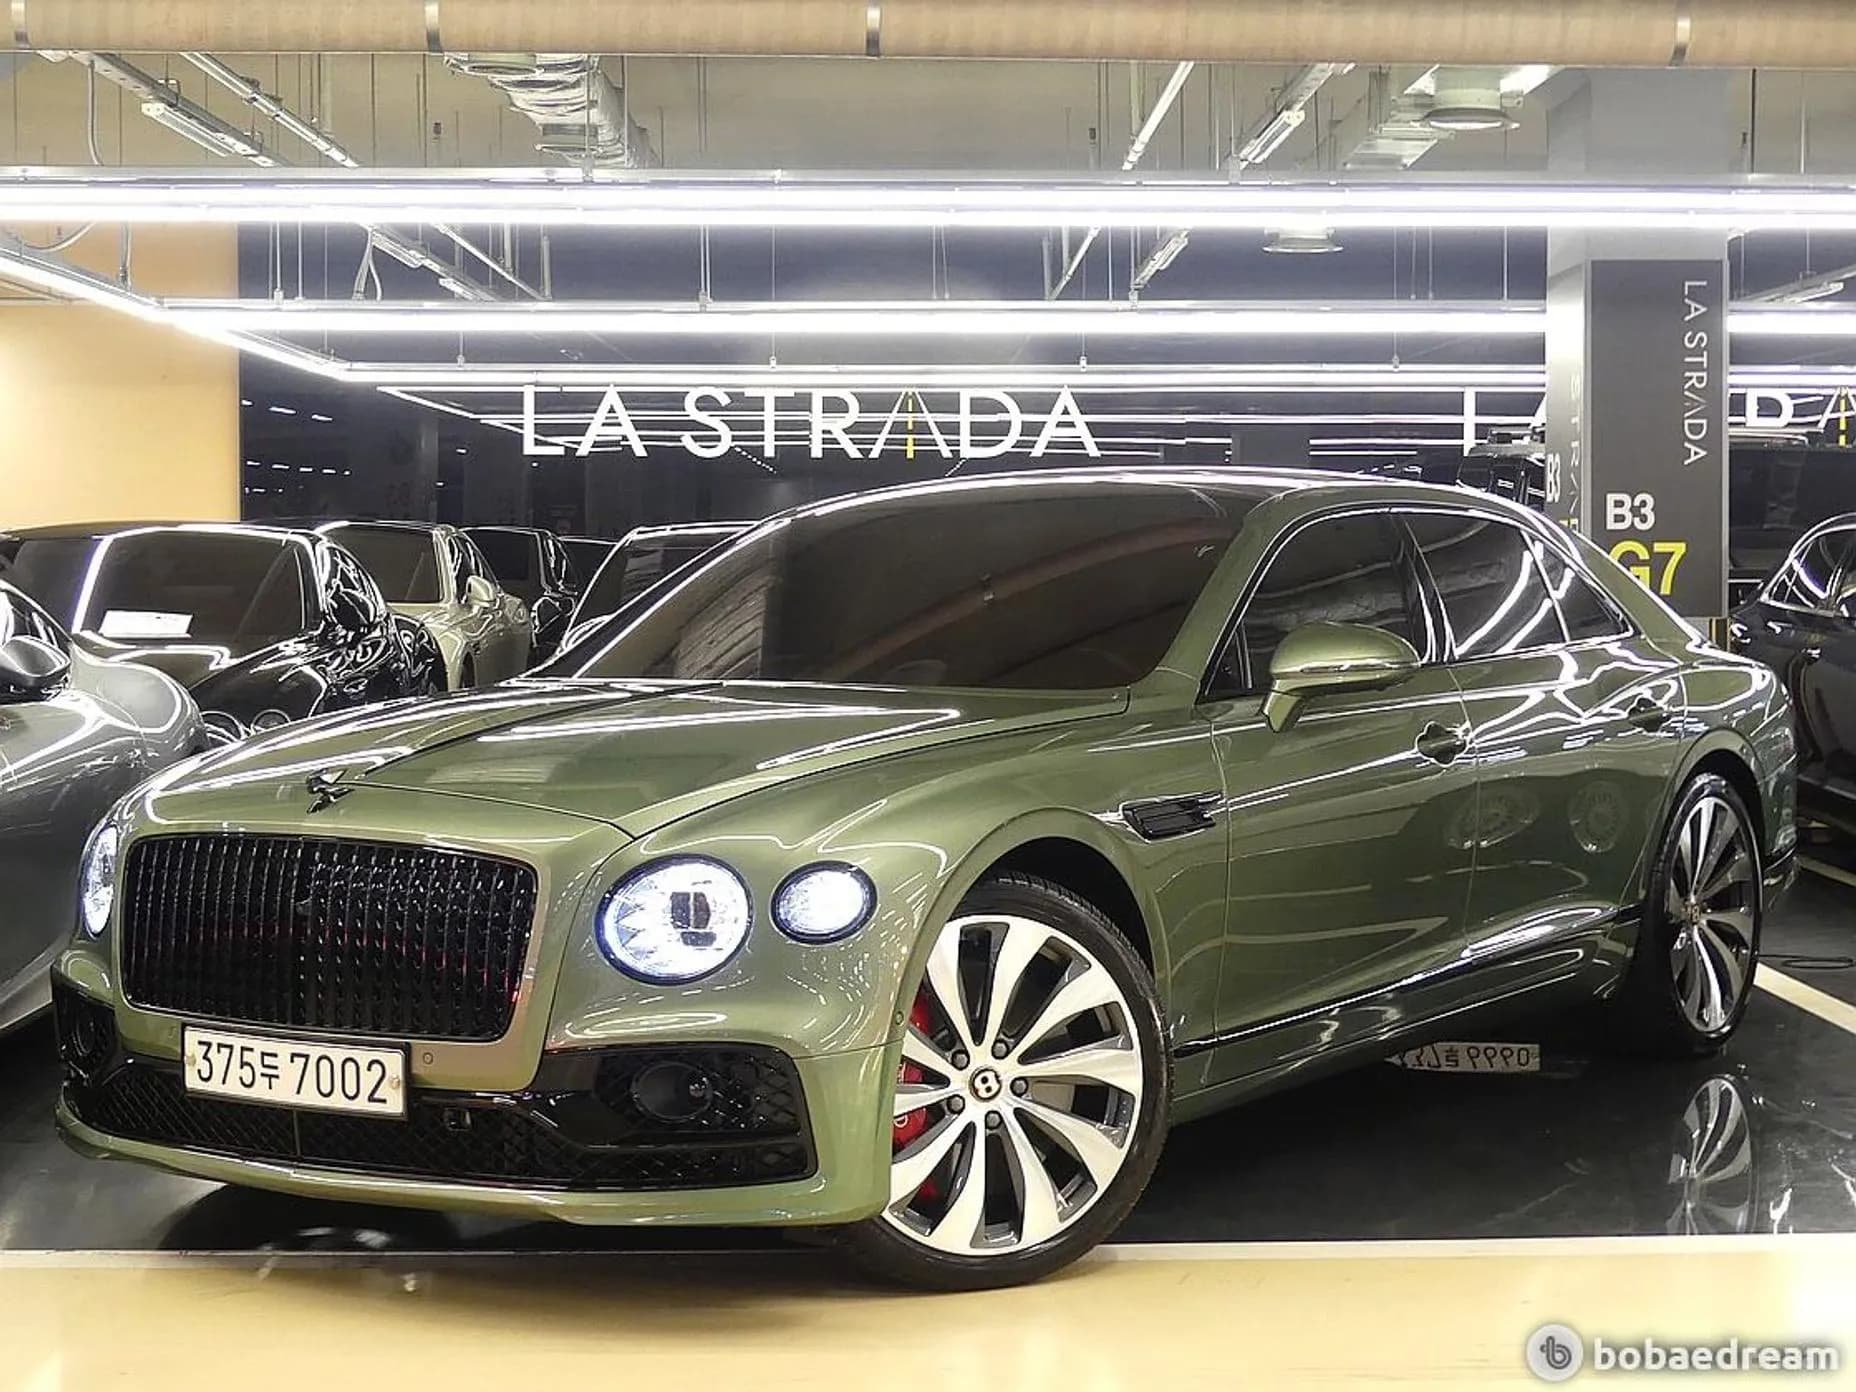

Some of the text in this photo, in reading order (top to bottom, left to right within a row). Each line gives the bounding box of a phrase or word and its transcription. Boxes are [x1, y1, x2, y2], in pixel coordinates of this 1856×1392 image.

[1683, 280, 1708, 466] LA STRADA
[522, 383, 1101, 459] LA STRADA
[1605, 493, 1656, 531] B3
[1608, 540, 1687, 596] G7
[197, 1039, 388, 1104] 375두 7002
